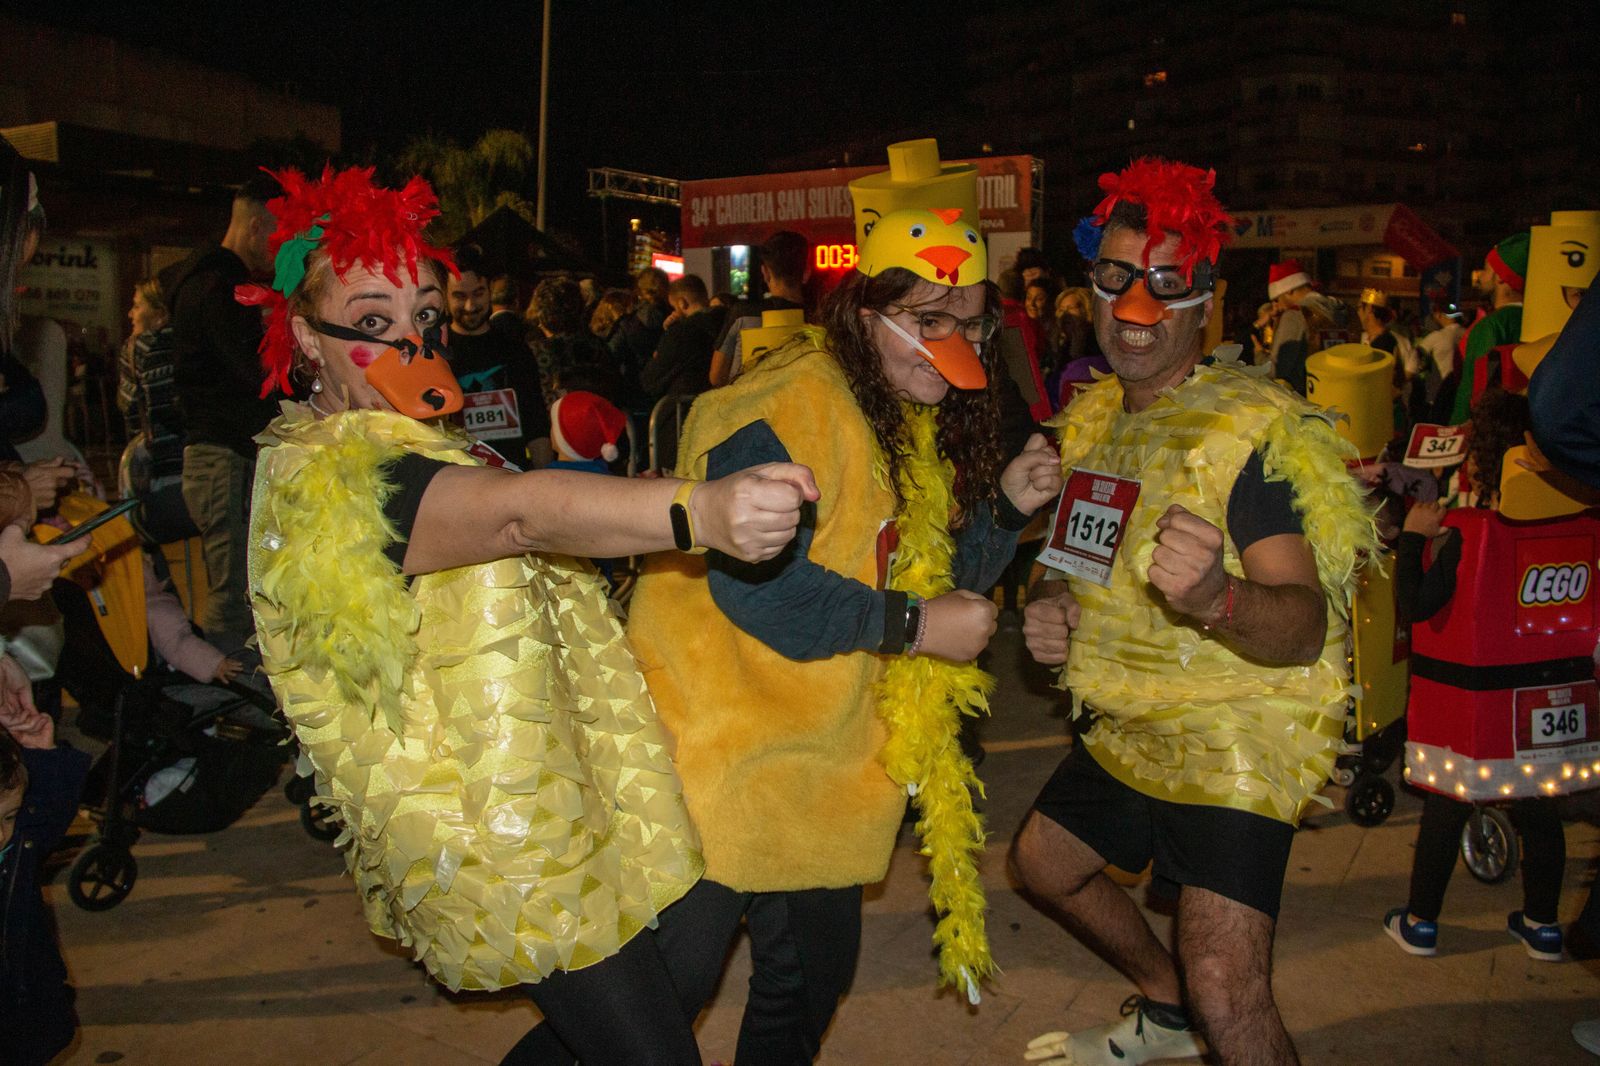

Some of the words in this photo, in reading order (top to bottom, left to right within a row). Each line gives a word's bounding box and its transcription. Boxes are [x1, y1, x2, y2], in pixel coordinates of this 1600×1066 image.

[715, 191, 775, 225] CARRERA
[777, 188, 806, 221] SAN
[808, 186, 852, 219] SILVES
[976, 174, 1019, 209] OTRIL
[465, 409, 505, 425] 1881
[1427, 437, 1458, 453] 347
[1070, 511, 1119, 548] 1512
[1520, 564, 1589, 605] LEGO
[1541, 708, 1579, 737] 346
